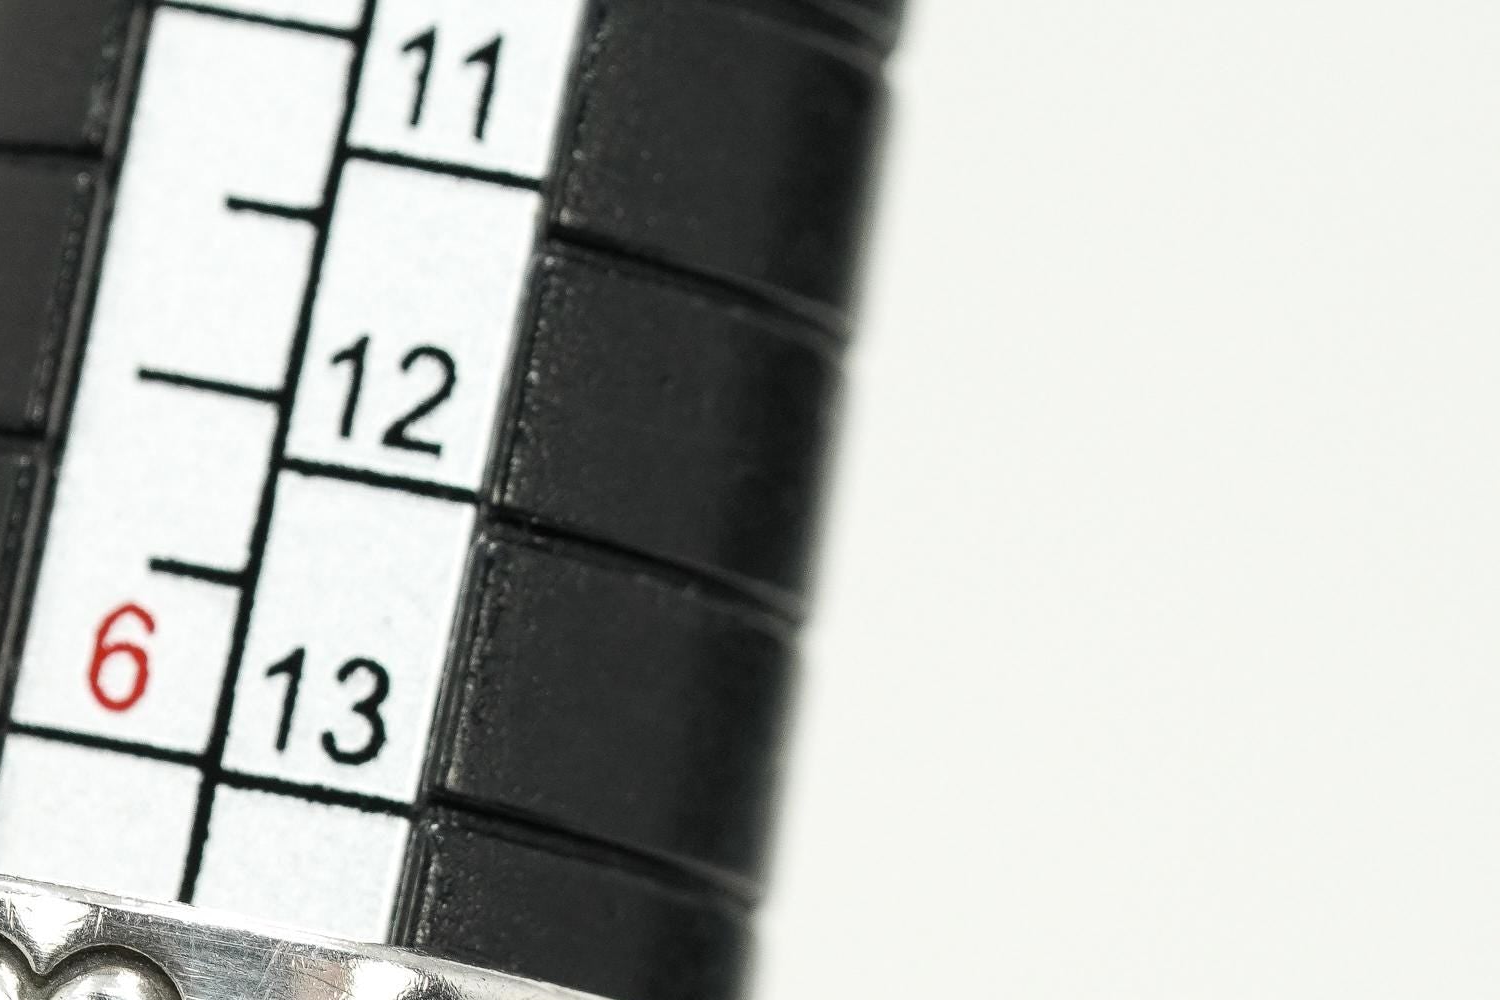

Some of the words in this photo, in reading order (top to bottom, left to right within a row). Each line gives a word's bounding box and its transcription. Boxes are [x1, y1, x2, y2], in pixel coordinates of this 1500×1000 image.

[401, 23, 504, 142] 11
[329, 334, 457, 458] 12
[87, 601, 157, 712] 6
[265, 647, 392, 766] 13
